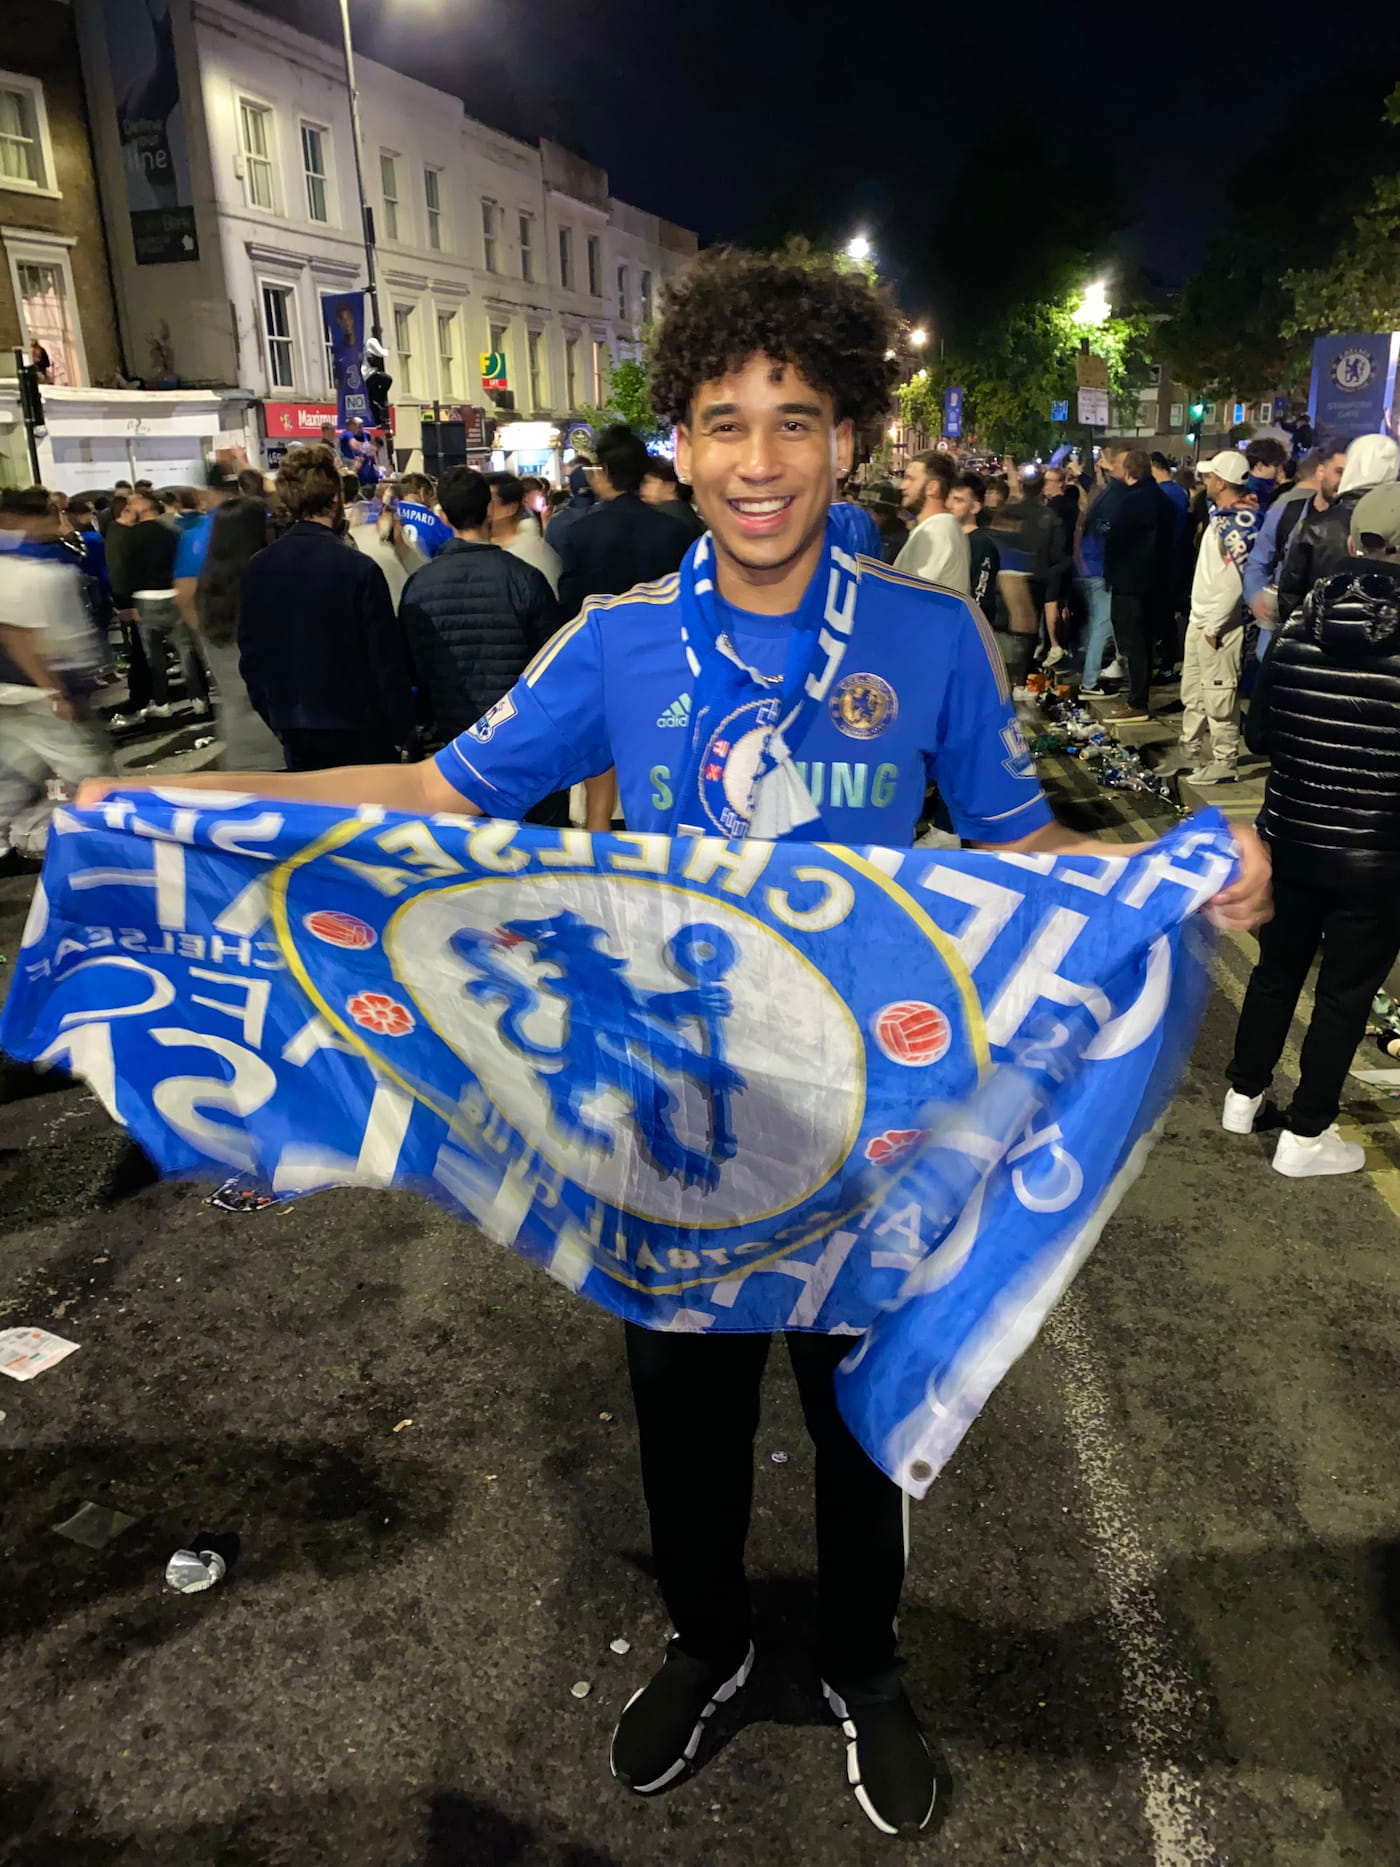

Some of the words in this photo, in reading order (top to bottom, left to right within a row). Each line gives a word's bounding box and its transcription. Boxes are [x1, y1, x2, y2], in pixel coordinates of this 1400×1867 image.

[396, 506, 435, 526] AMPARD
[656, 713, 691, 728] adid
[650, 762, 898, 811] SUNG
